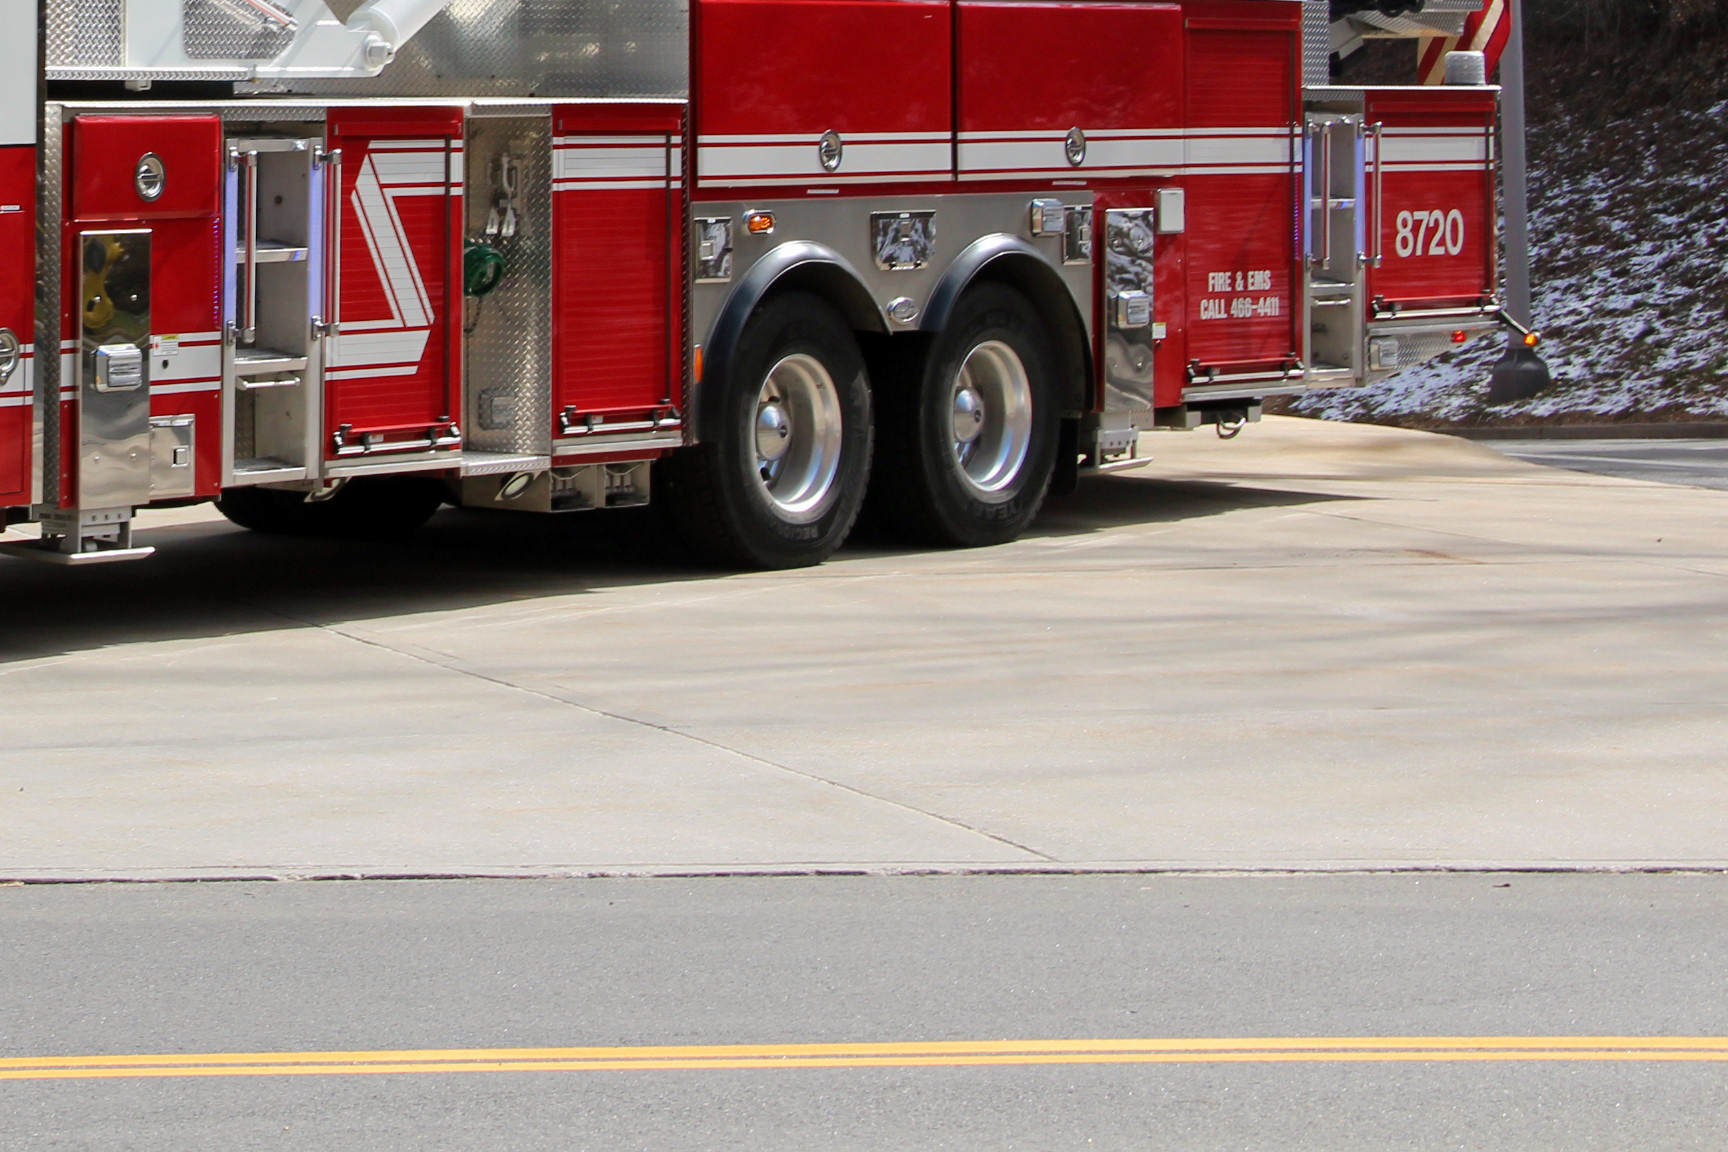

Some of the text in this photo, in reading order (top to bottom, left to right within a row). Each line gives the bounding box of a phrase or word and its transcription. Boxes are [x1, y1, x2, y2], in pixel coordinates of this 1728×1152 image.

[1396, 209, 1464, 257] 8720
[1207, 269, 1272, 293] FIRE & EMS
[1200, 295, 1280, 321] CALL 466-4411
